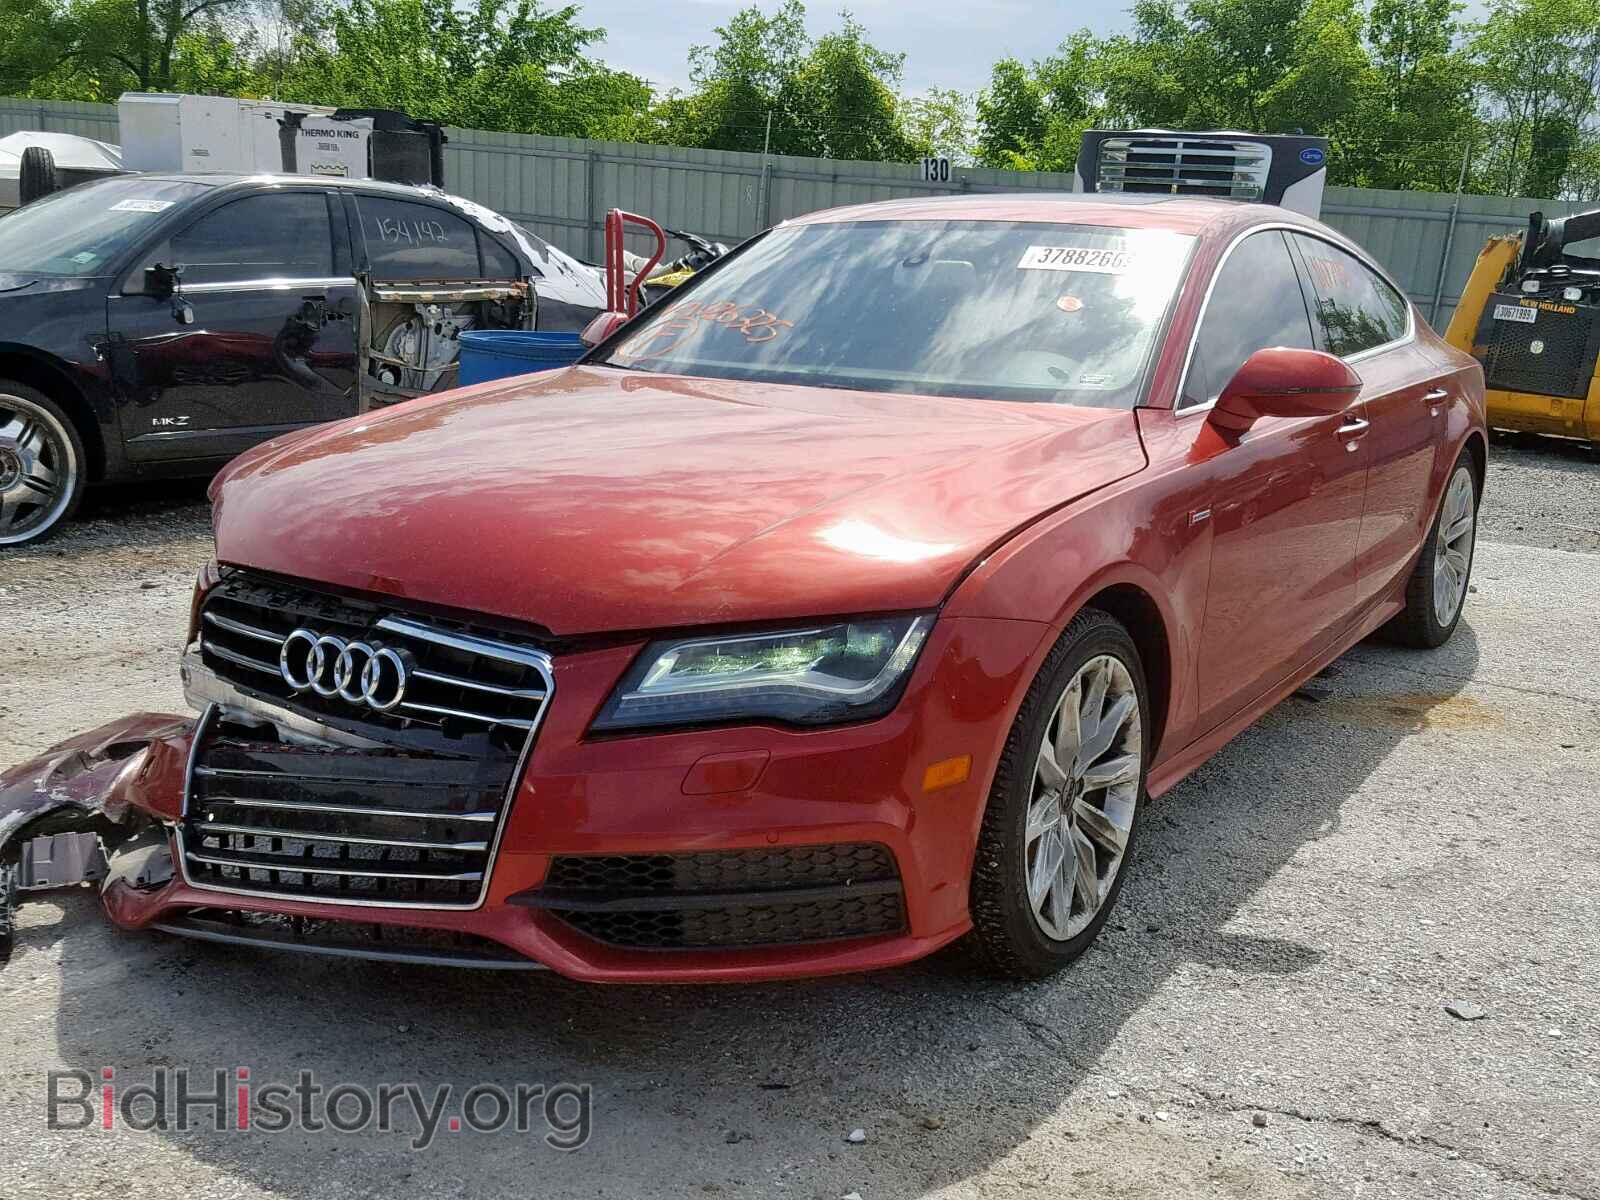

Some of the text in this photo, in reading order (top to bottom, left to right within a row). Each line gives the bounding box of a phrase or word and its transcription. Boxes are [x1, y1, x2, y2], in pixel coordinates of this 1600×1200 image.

[302, 129, 359, 139] THERMO KING
[924, 158, 949, 181] 130
[1520, 298, 1576, 314] NEW HOLLAND
